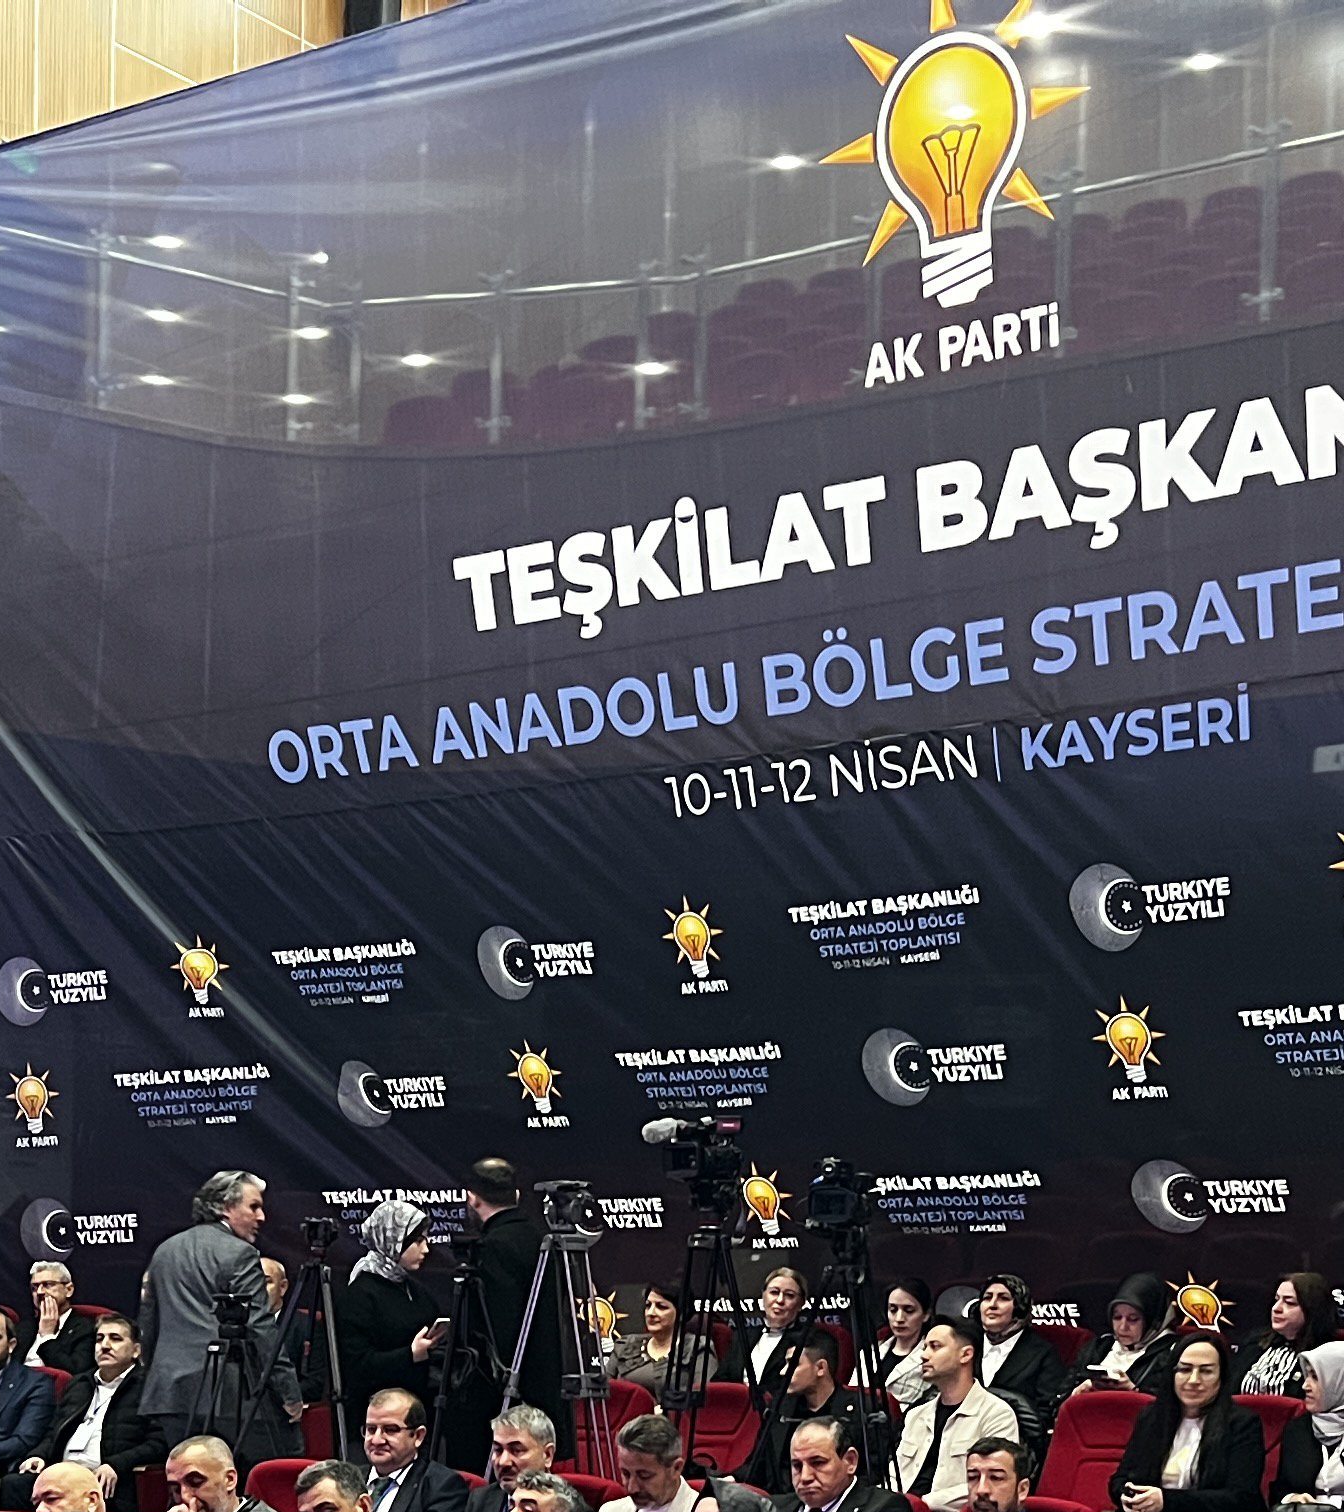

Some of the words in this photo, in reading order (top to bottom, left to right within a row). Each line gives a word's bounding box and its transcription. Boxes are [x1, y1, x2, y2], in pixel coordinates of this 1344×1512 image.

[864, 332, 925, 389] AK
[452, 474, 886, 640] TEŞKİLAT
[267, 713, 420, 785] ORTA
[431, 661, 741, 765] ANADOLU
[761, 617, 1010, 718] BÖLGE
[663, 758, 817, 818] 10-11-12
[829, 734, 979, 797] NİSAN
[1020, 682, 1252, 773] KAYSERİ
[787, 899, 868, 926] TEŞKİLAT
[871, 883, 980, 917] BAŞKANLIĞI
[1237, 1004, 1334, 1031] TEŞKİLAT
[1263, 1031, 1307, 1046] ORTA
[1275, 1045, 1344, 1064] STRATEJİ
[1112, 1086, 1131, 1101] AK
[396, 1188, 467, 1206] BAŞKANLI
[867, 1174, 932, 1196] ŞKİLAT
